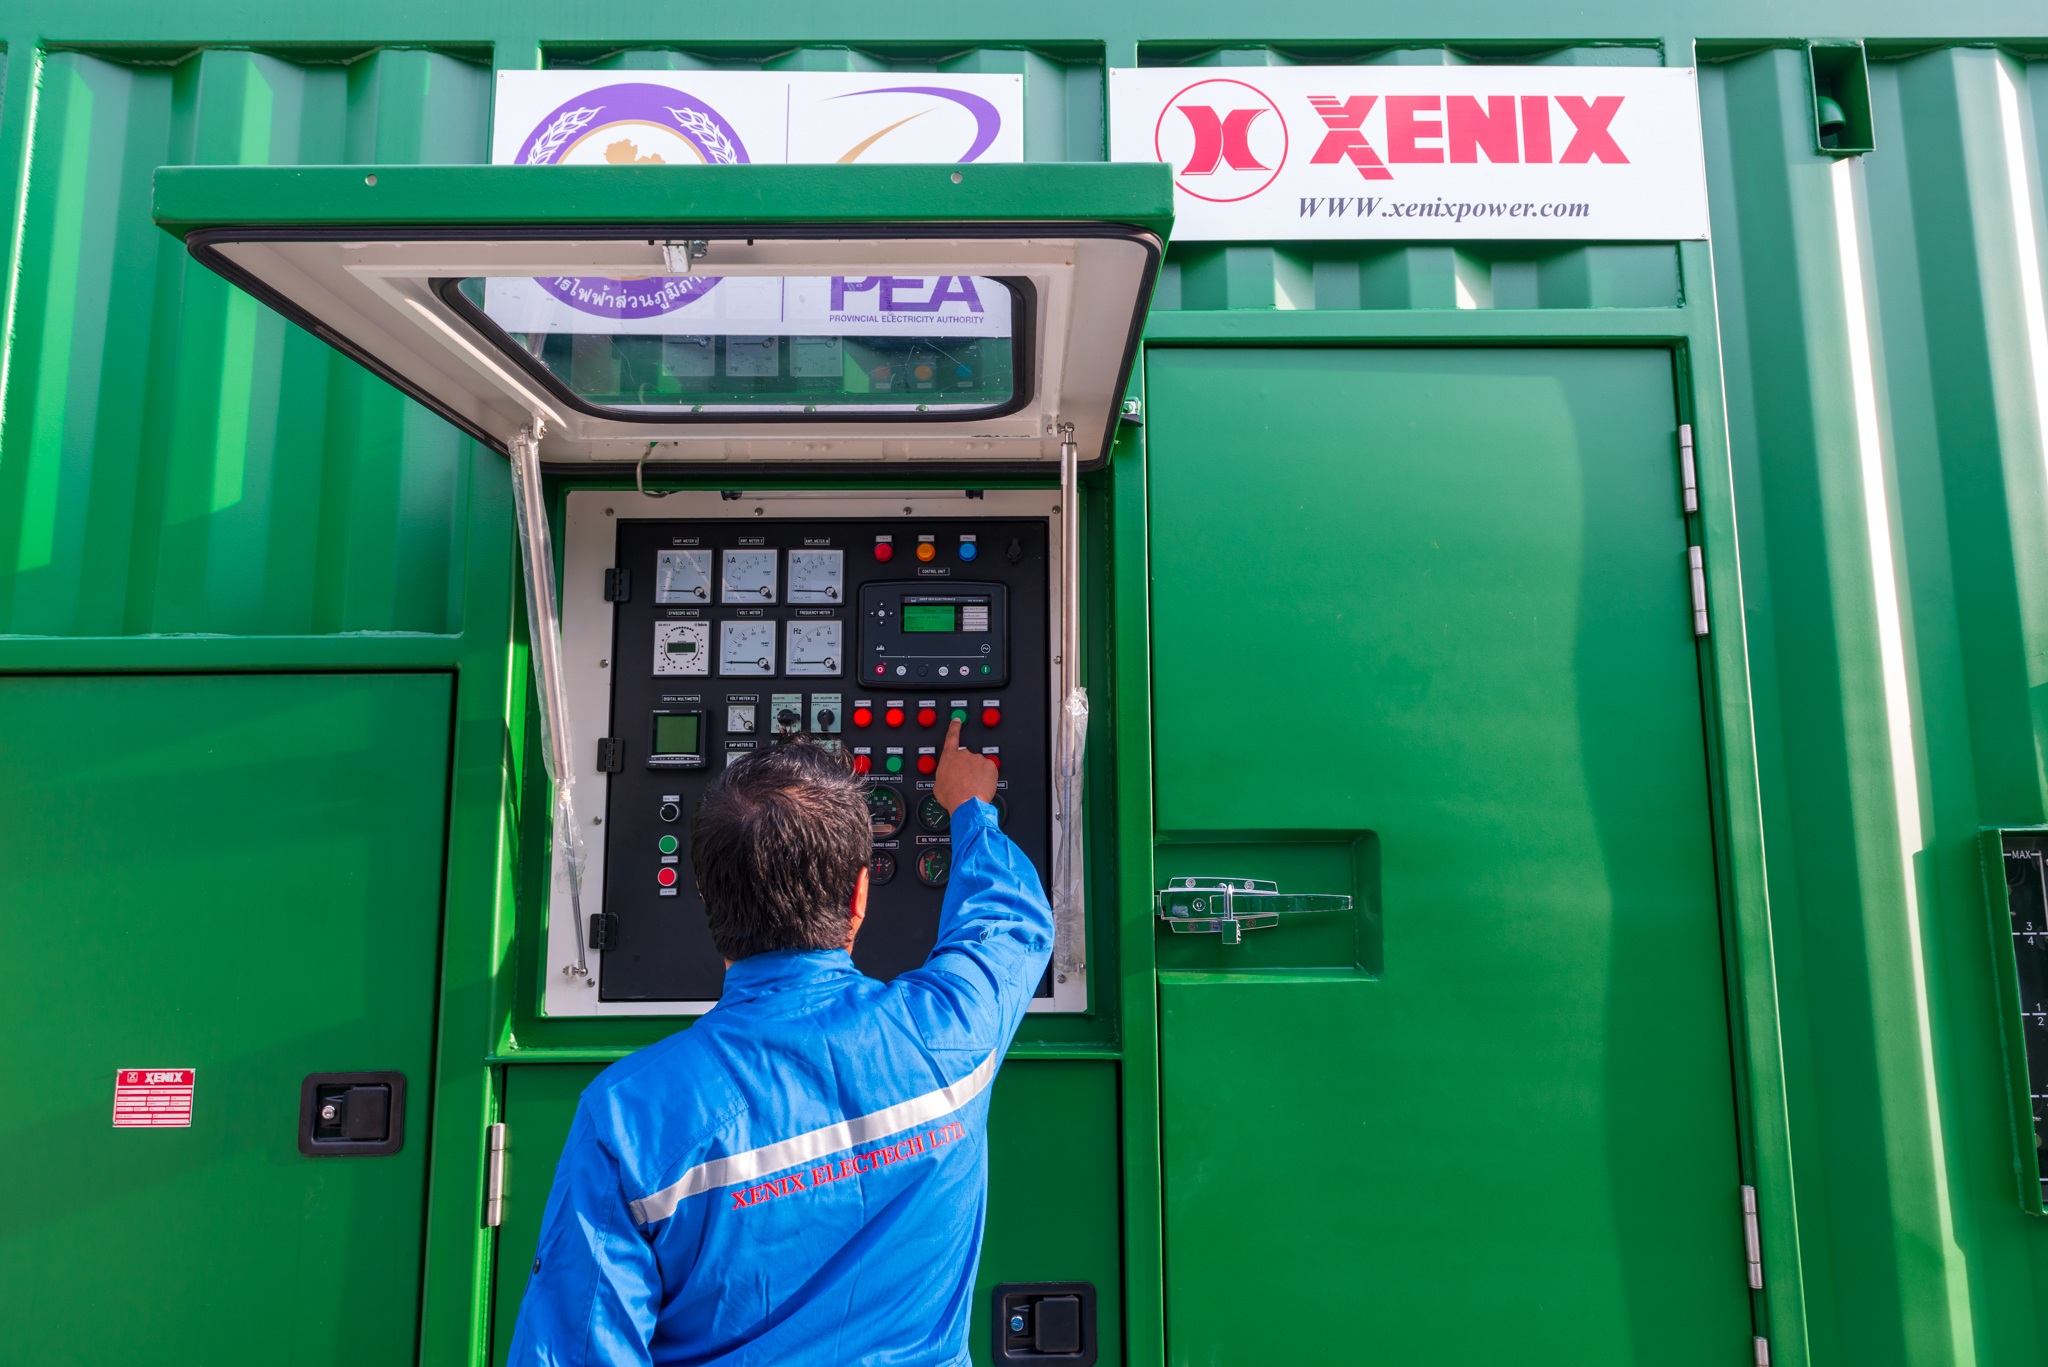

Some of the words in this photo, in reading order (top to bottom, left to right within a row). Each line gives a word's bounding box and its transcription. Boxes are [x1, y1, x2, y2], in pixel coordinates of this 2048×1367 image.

[1306, 94, 1631, 180] XENIX
[1298, 196, 1591, 223] WWW.xenixpower.com
[830, 276, 985, 313] PEA
[829, 315, 879, 323] PROVINCIAL
[881, 315, 934, 323] ELECTRICITY
[936, 315, 985, 324] AUTHORITY
[2012, 850, 2031, 859] MAX
[2026, 922, 2033, 931] 3
[2027, 936, 2034, 946] 4
[2036, 1003, 2041, 1011] 1
[2038, 1017, 2044, 1026] 2
[144, 1072, 184, 1084] XENIX
[731, 1172, 807, 1210] XENIX
[811, 1134, 926, 1187] ELECTECH
